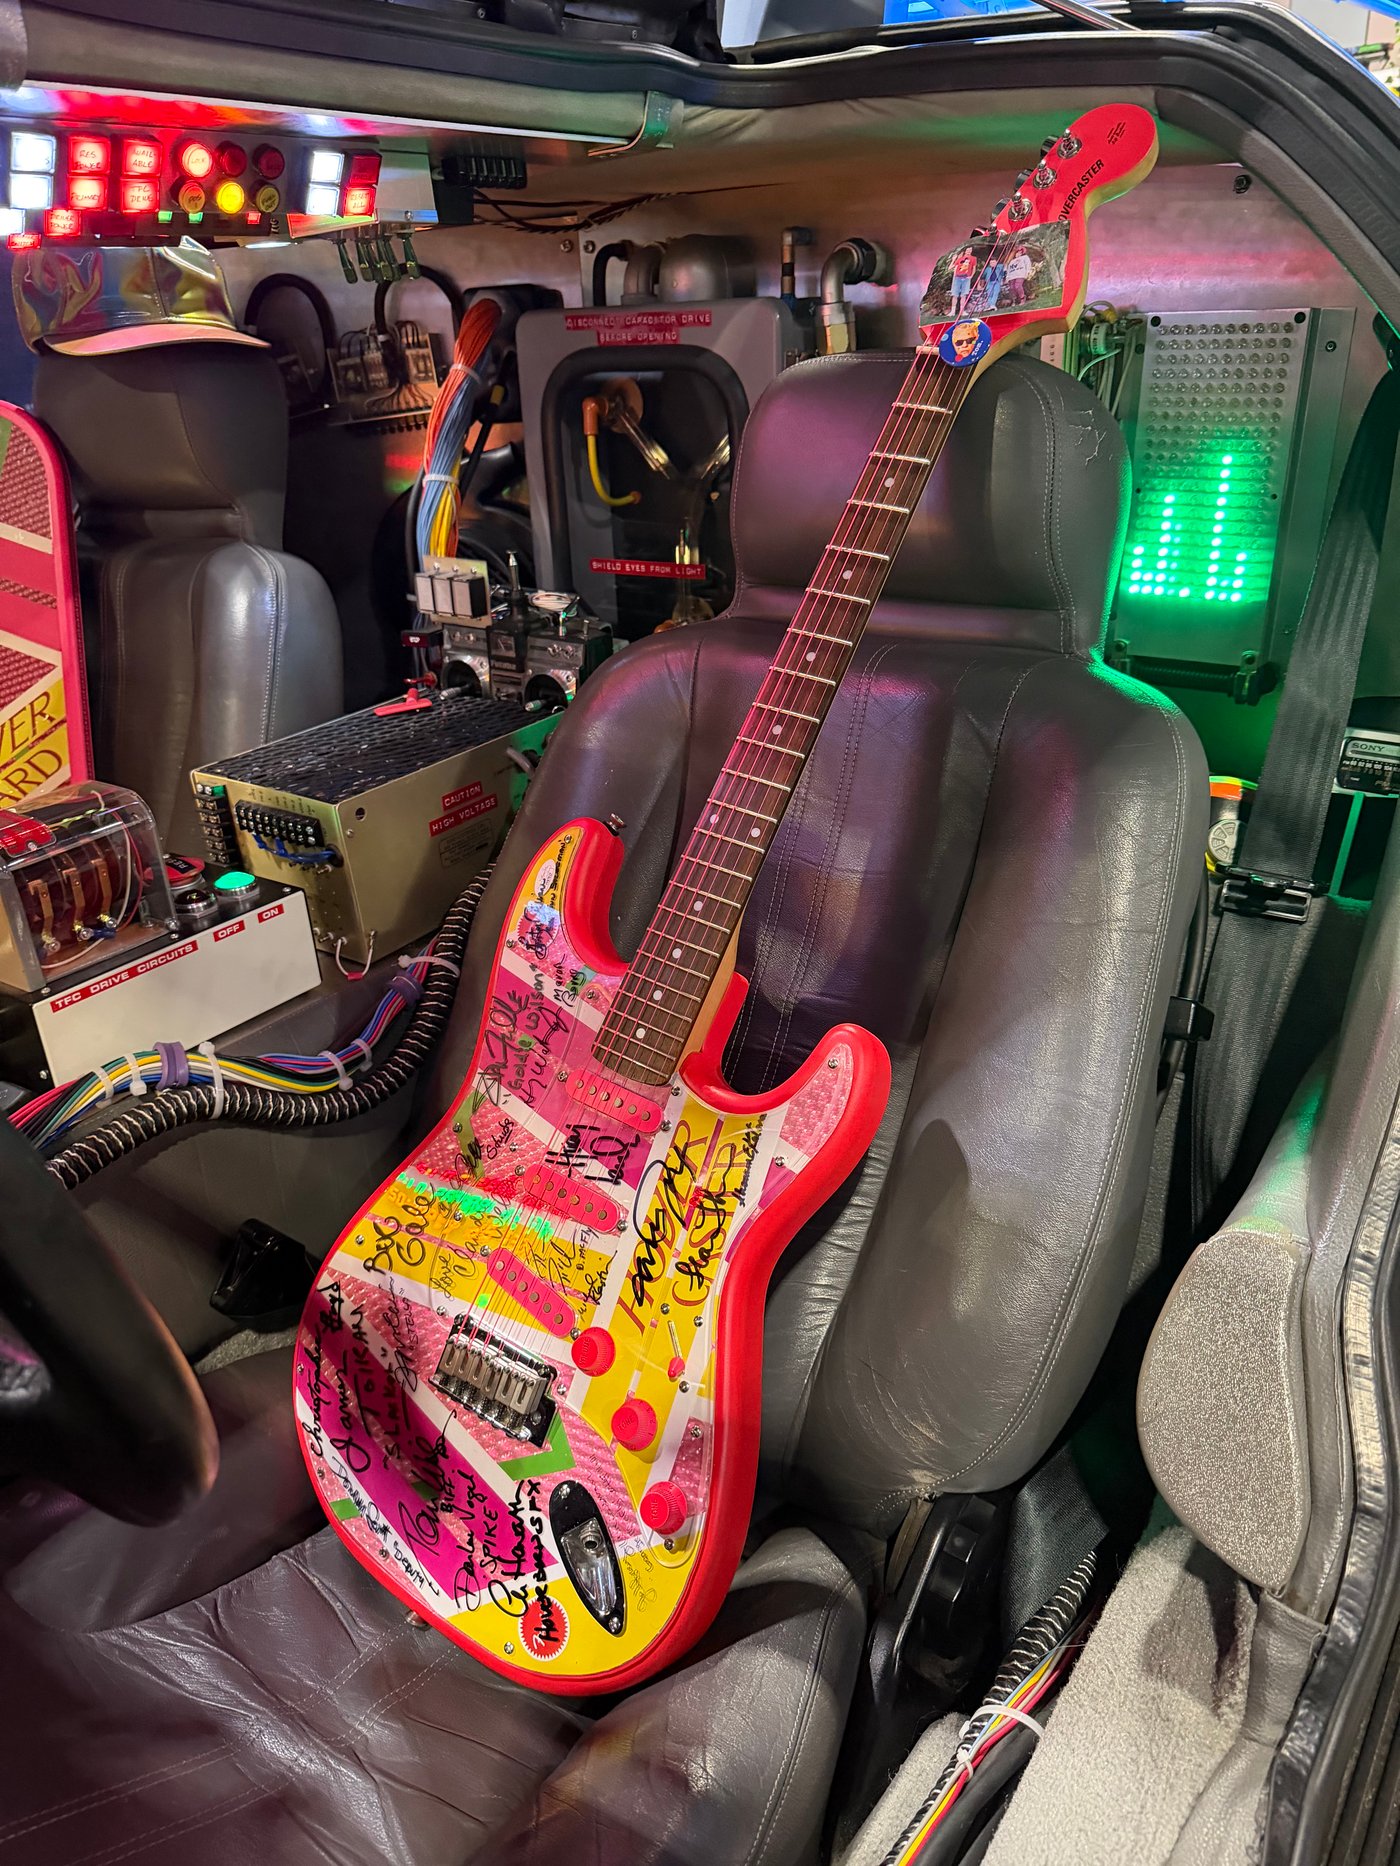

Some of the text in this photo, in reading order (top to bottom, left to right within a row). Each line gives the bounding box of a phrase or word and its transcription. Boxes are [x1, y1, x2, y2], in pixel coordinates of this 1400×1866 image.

[1058, 159, 1105, 221] OVERCASTER
[681, 313, 711, 324] DRIVE
[637, 330, 677, 341] OPENING
[592, 561, 701, 575] SHIELD EYES FROM LIGHT
[1352, 742, 1385, 752] SONY
[444, 785, 481, 807] CAUTION
[432, 797, 496, 832] HIGH VOLTAGE
[261, 907, 279, 920] ON
[217, 923, 241, 939] OFF
[55, 944, 194, 1009] TFC DRIVE CIRCUITS
[617, 1119, 708, 1335] HOVER
[672, 1142, 748, 1308] CASTER
[617, 1415, 634, 1431] TONE
